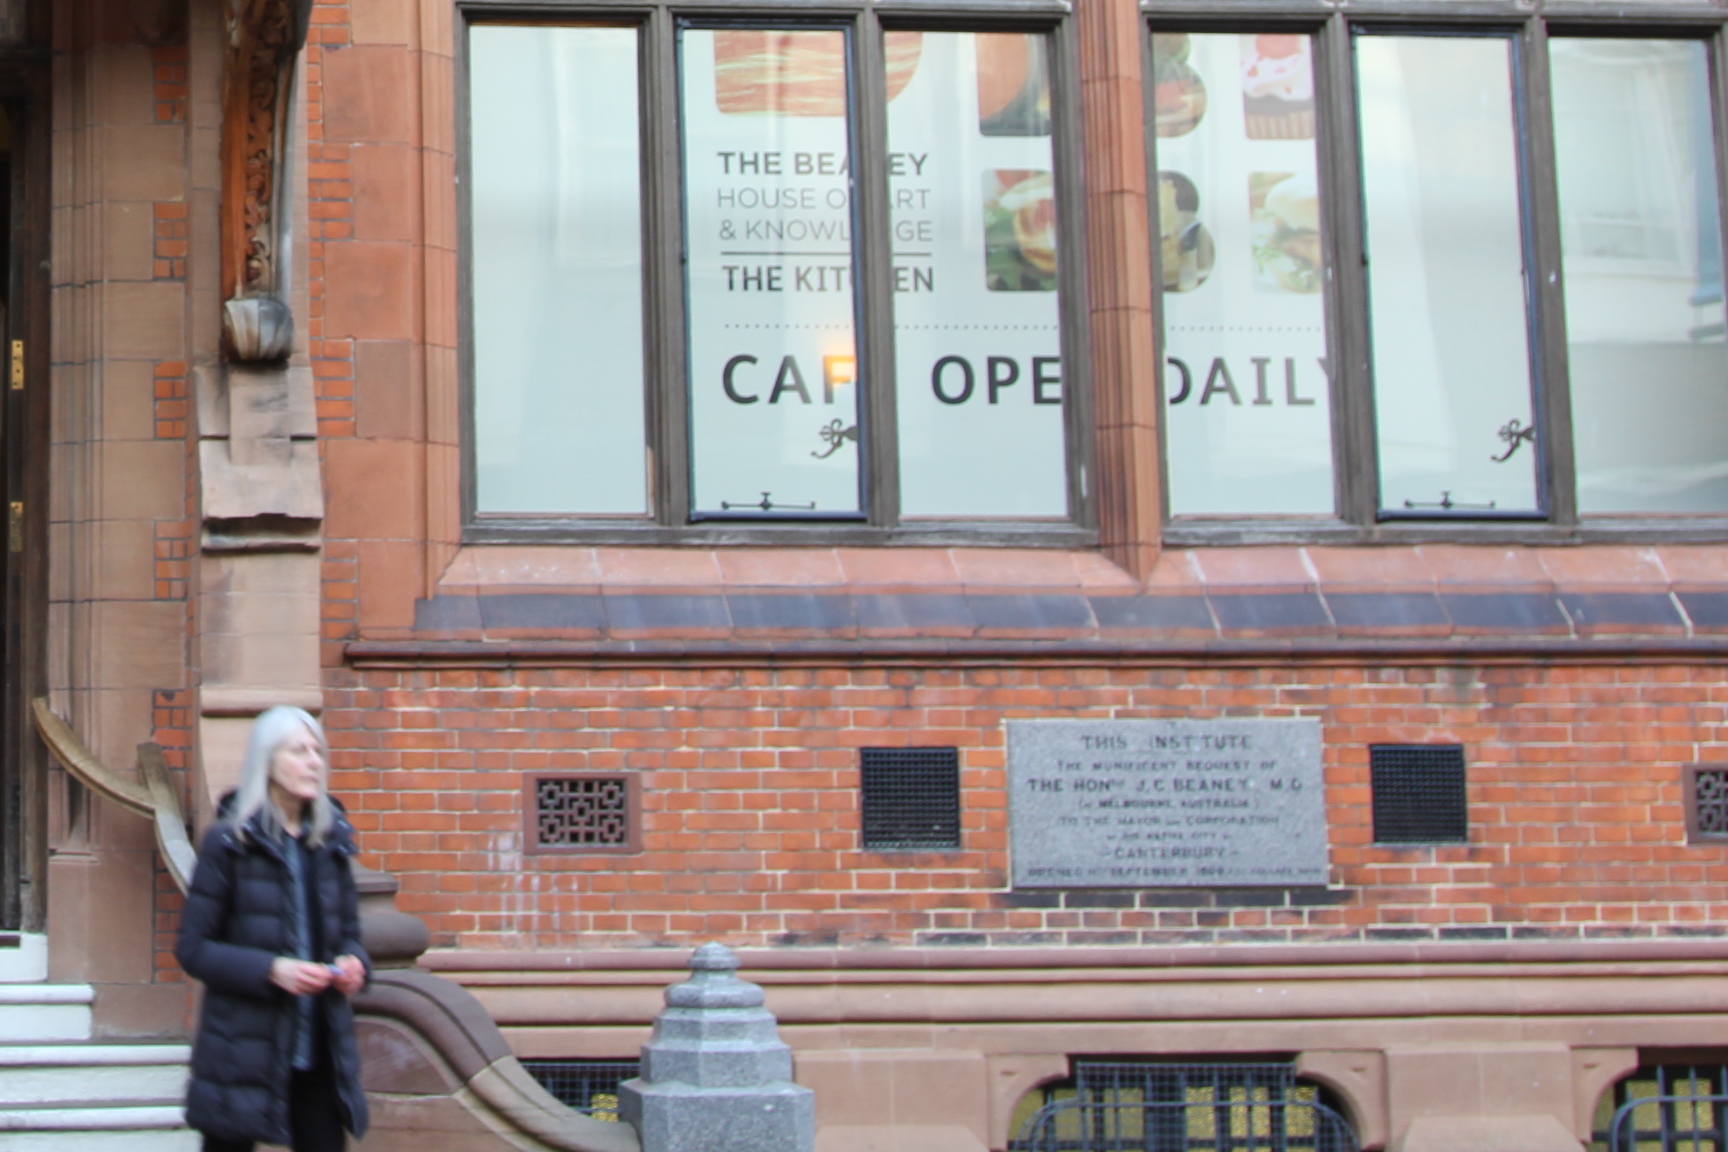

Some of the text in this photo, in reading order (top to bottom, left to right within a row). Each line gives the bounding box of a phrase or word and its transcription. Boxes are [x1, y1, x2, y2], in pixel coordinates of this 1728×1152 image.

[717, 152, 928, 175] THE BEEY
[717, 187, 931, 209] HOUSE O RT
[719, 219, 933, 242] & KNOWLGE
[722, 266, 934, 292] THE KITEN
[722, 354, 857, 404] CAF
[931, 355, 1062, 405] OPE
[1081, 734, 1252, 750] THIS INSTTUTE
[1058, 759, 1083, 772] THE
[1028, 778, 1064, 792] THE
